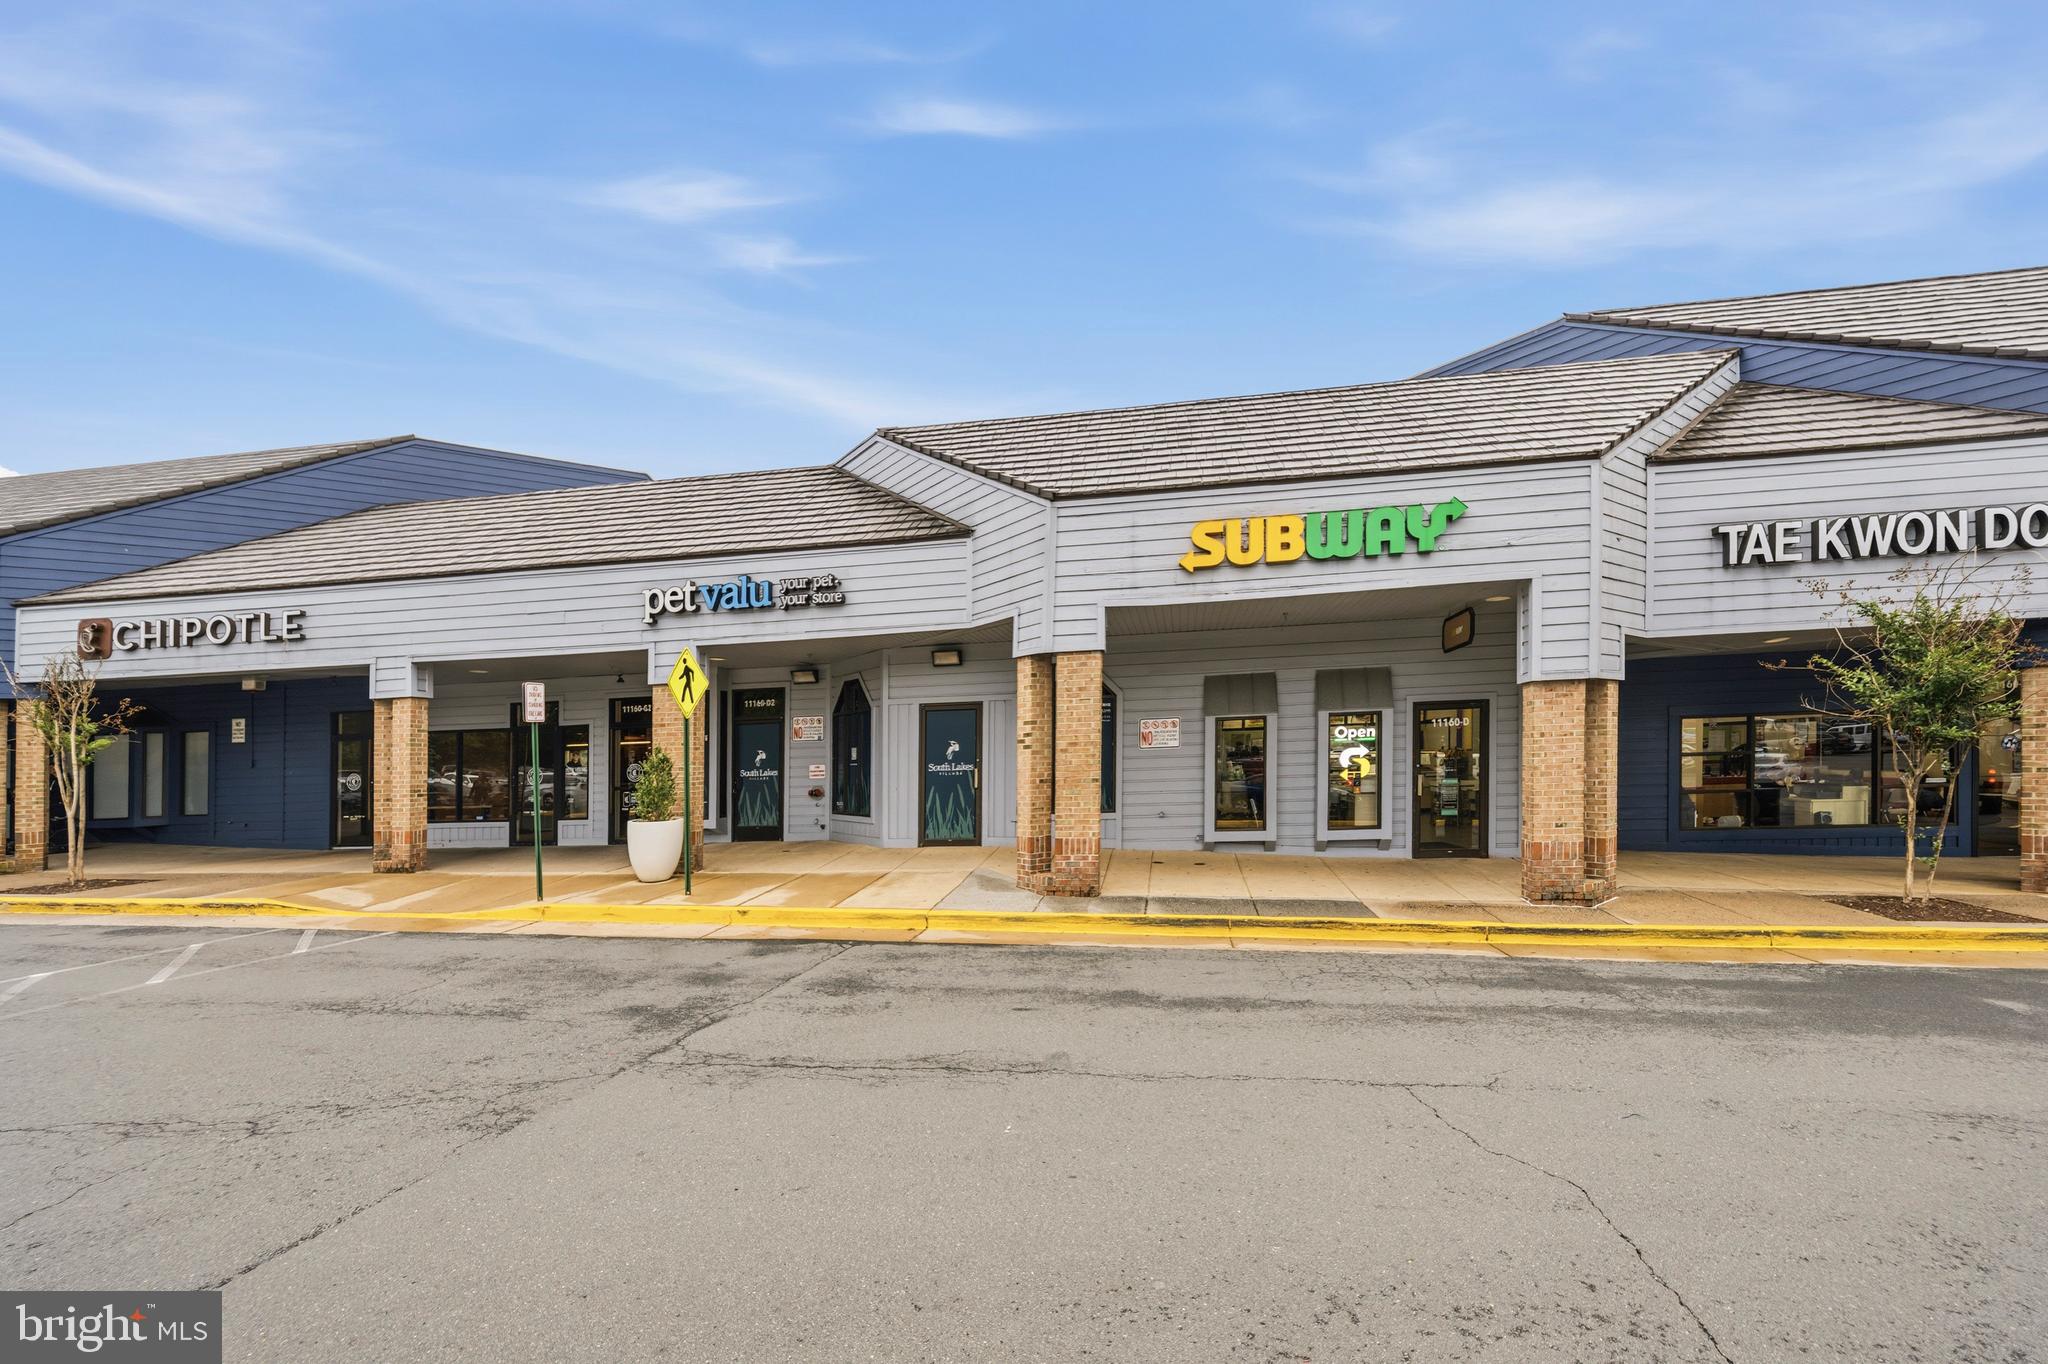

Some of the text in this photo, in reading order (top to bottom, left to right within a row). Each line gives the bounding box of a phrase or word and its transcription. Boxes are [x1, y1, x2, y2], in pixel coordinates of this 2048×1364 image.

[1179, 497, 1468, 573] SUBWAY
[1715, 520, 1803, 567] TAE
[1813, 510, 1969, 560] KWON
[780, 578, 808, 593] your
[642, 575, 773, 624] pet valu
[780, 592, 842, 609] your store
[112, 609, 304, 651] CHIPOTLE
[1431, 717, 1470, 728] 11160-D
[1141, 730, 1153, 746] NO
[1334, 725, 1376, 741] Open
[928, 762, 974, 772] South Lakes
